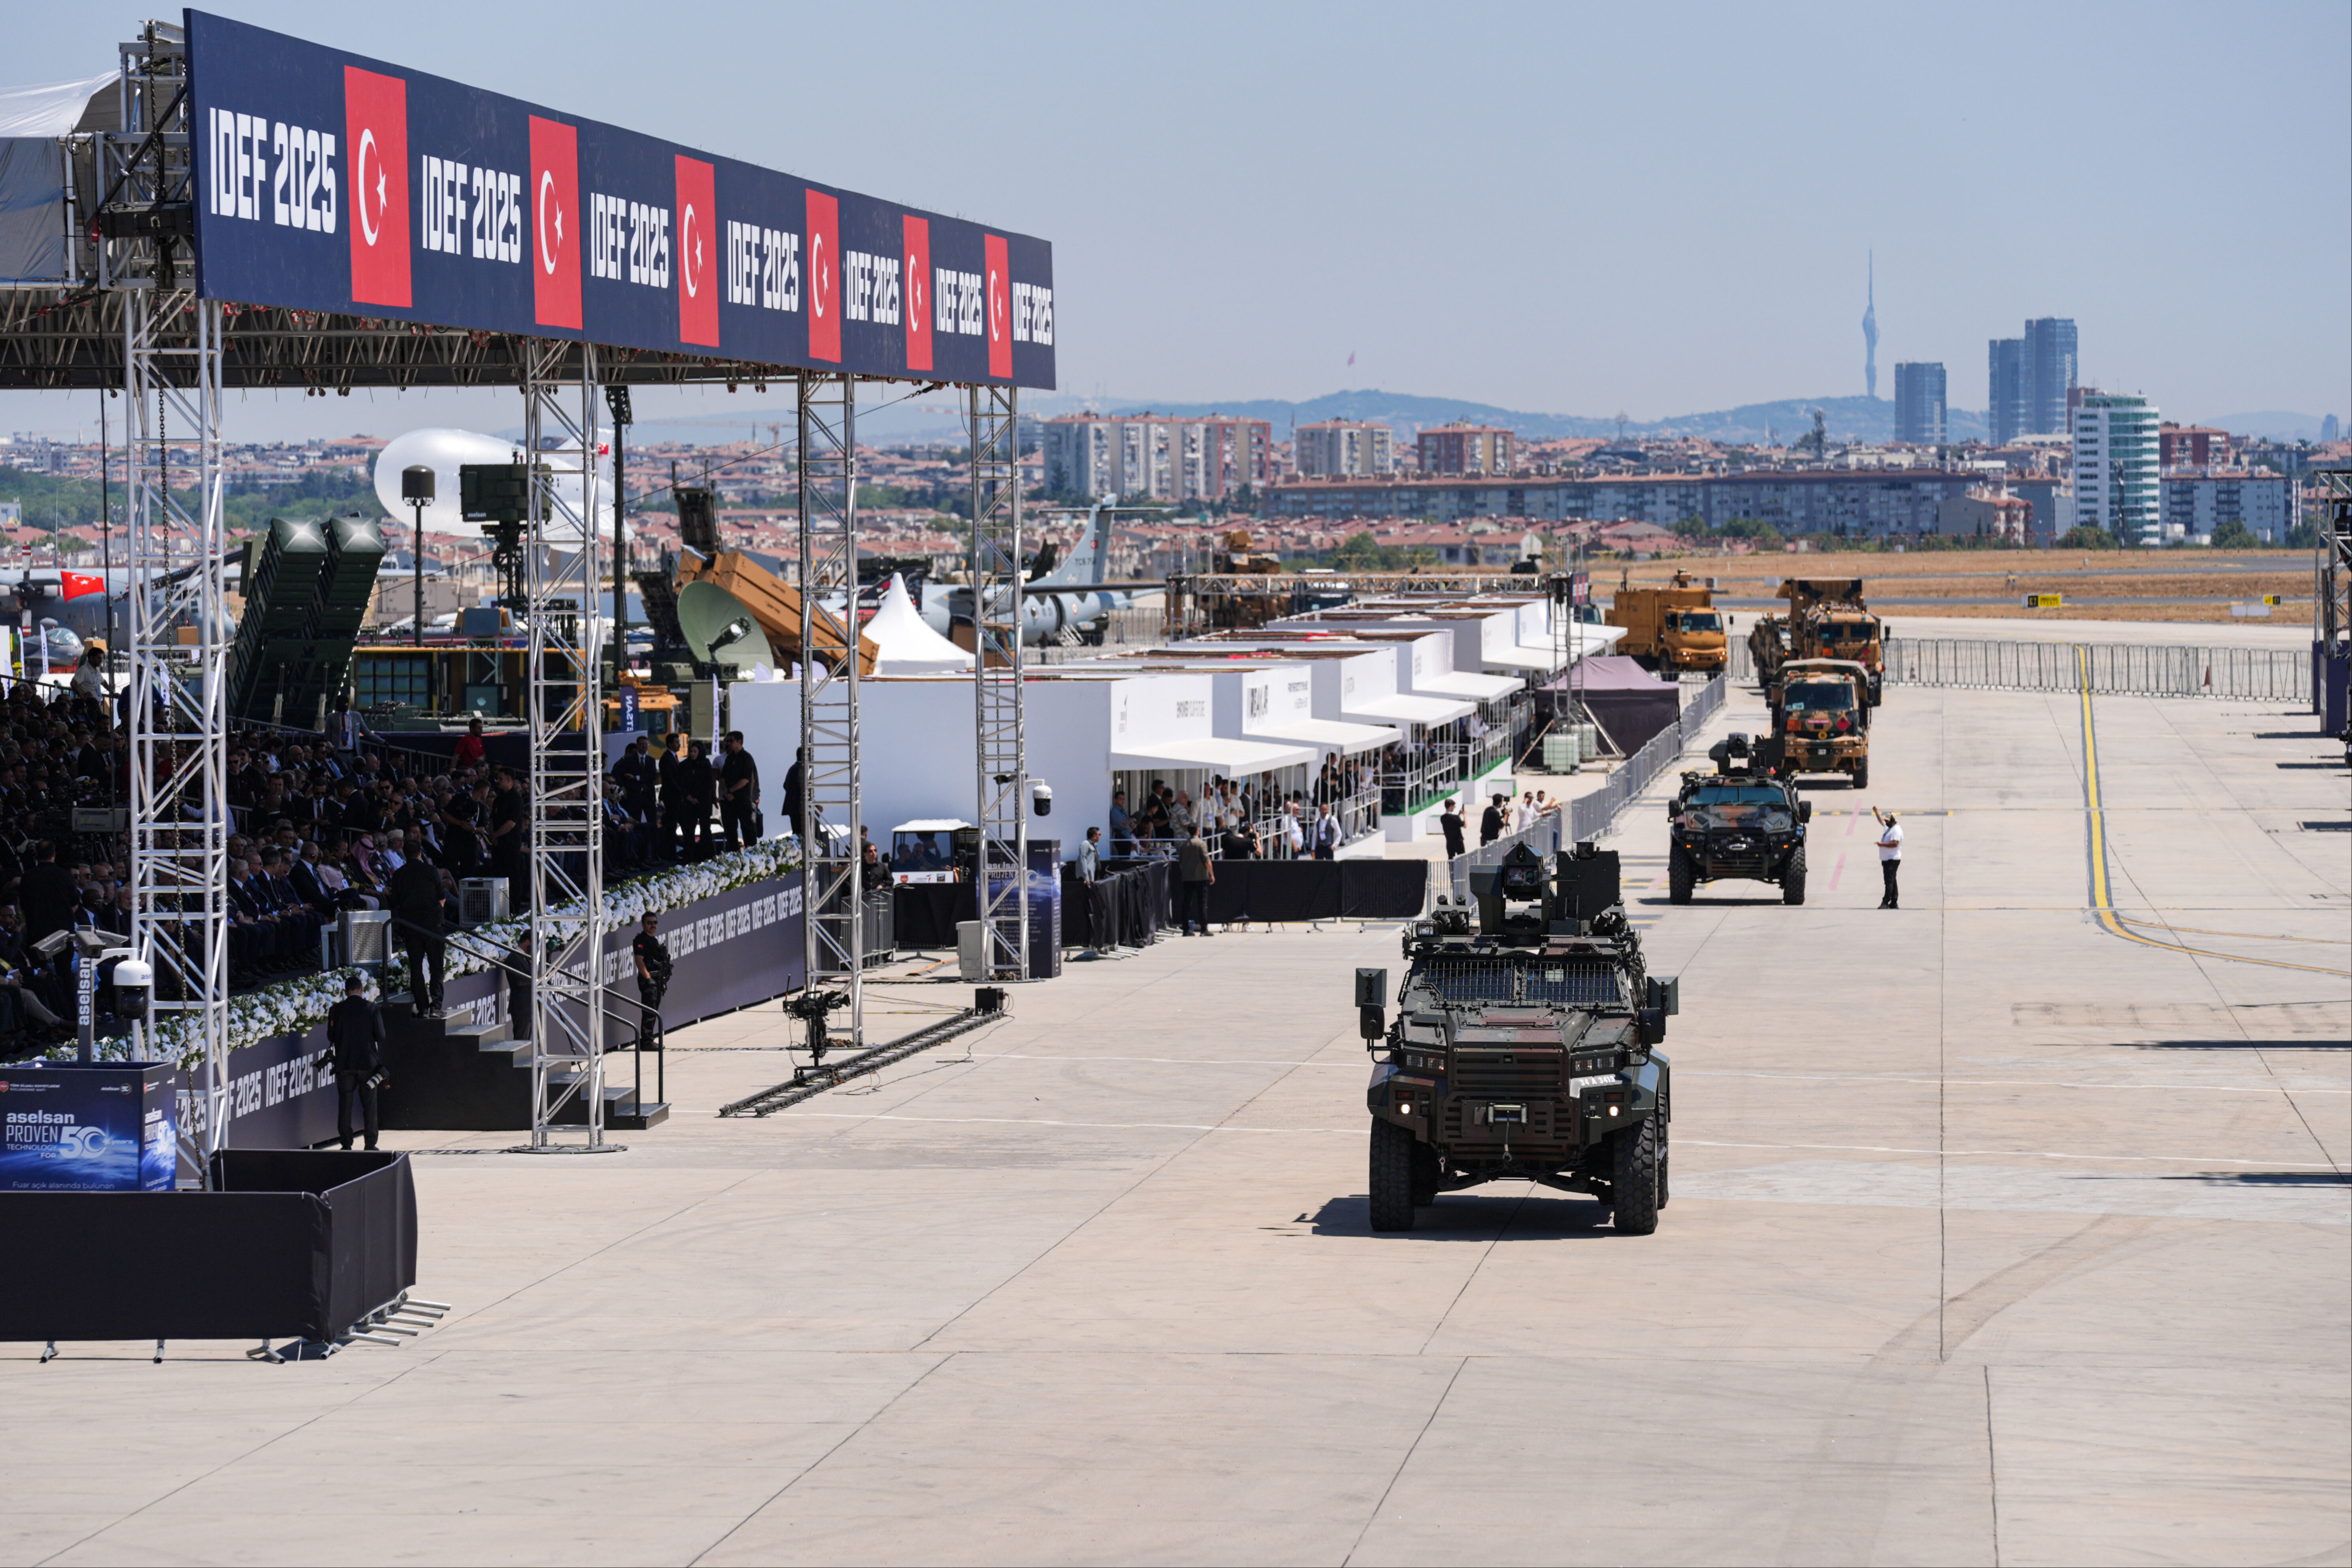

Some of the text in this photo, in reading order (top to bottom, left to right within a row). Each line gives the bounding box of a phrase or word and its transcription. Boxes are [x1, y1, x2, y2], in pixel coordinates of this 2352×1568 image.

[210, 108, 1052, 345] IDEF 2025 IDEF 2025 IDEF 2025 IDEF 2025 IDEF 2025 IDEF 2025 IDEF 2025
[77, 957, 91, 1025] aselsan
[236, 1071, 260, 1118] 2025
[266, 1062, 287, 1107] IDEF
[289, 1053, 313, 1098] 2025
[477, 994, 495, 1025] 2025
[499, 988, 511, 1025] IDE
[571, 962, 585, 996] IDEF
[604, 951, 618, 985] IDEF
[619, 945, 634, 980] 2025
[668, 928, 680, 960] IDEF
[681, 923, 694, 957] 2025
[696, 918, 709, 950] IDEF
[709, 913, 724, 945] 2025
[726, 908, 736, 940] IDEF
[737, 904, 751, 936] 2025
[752, 899, 763, 930] IDEF
[763, 895, 776, 926] 2025
[777, 890, 788, 921] IDEF
[789, 885, 802, 916] 2025
[6, 1109, 74, 1124] aselsan
[6, 1125, 58, 1142] PROVEN
